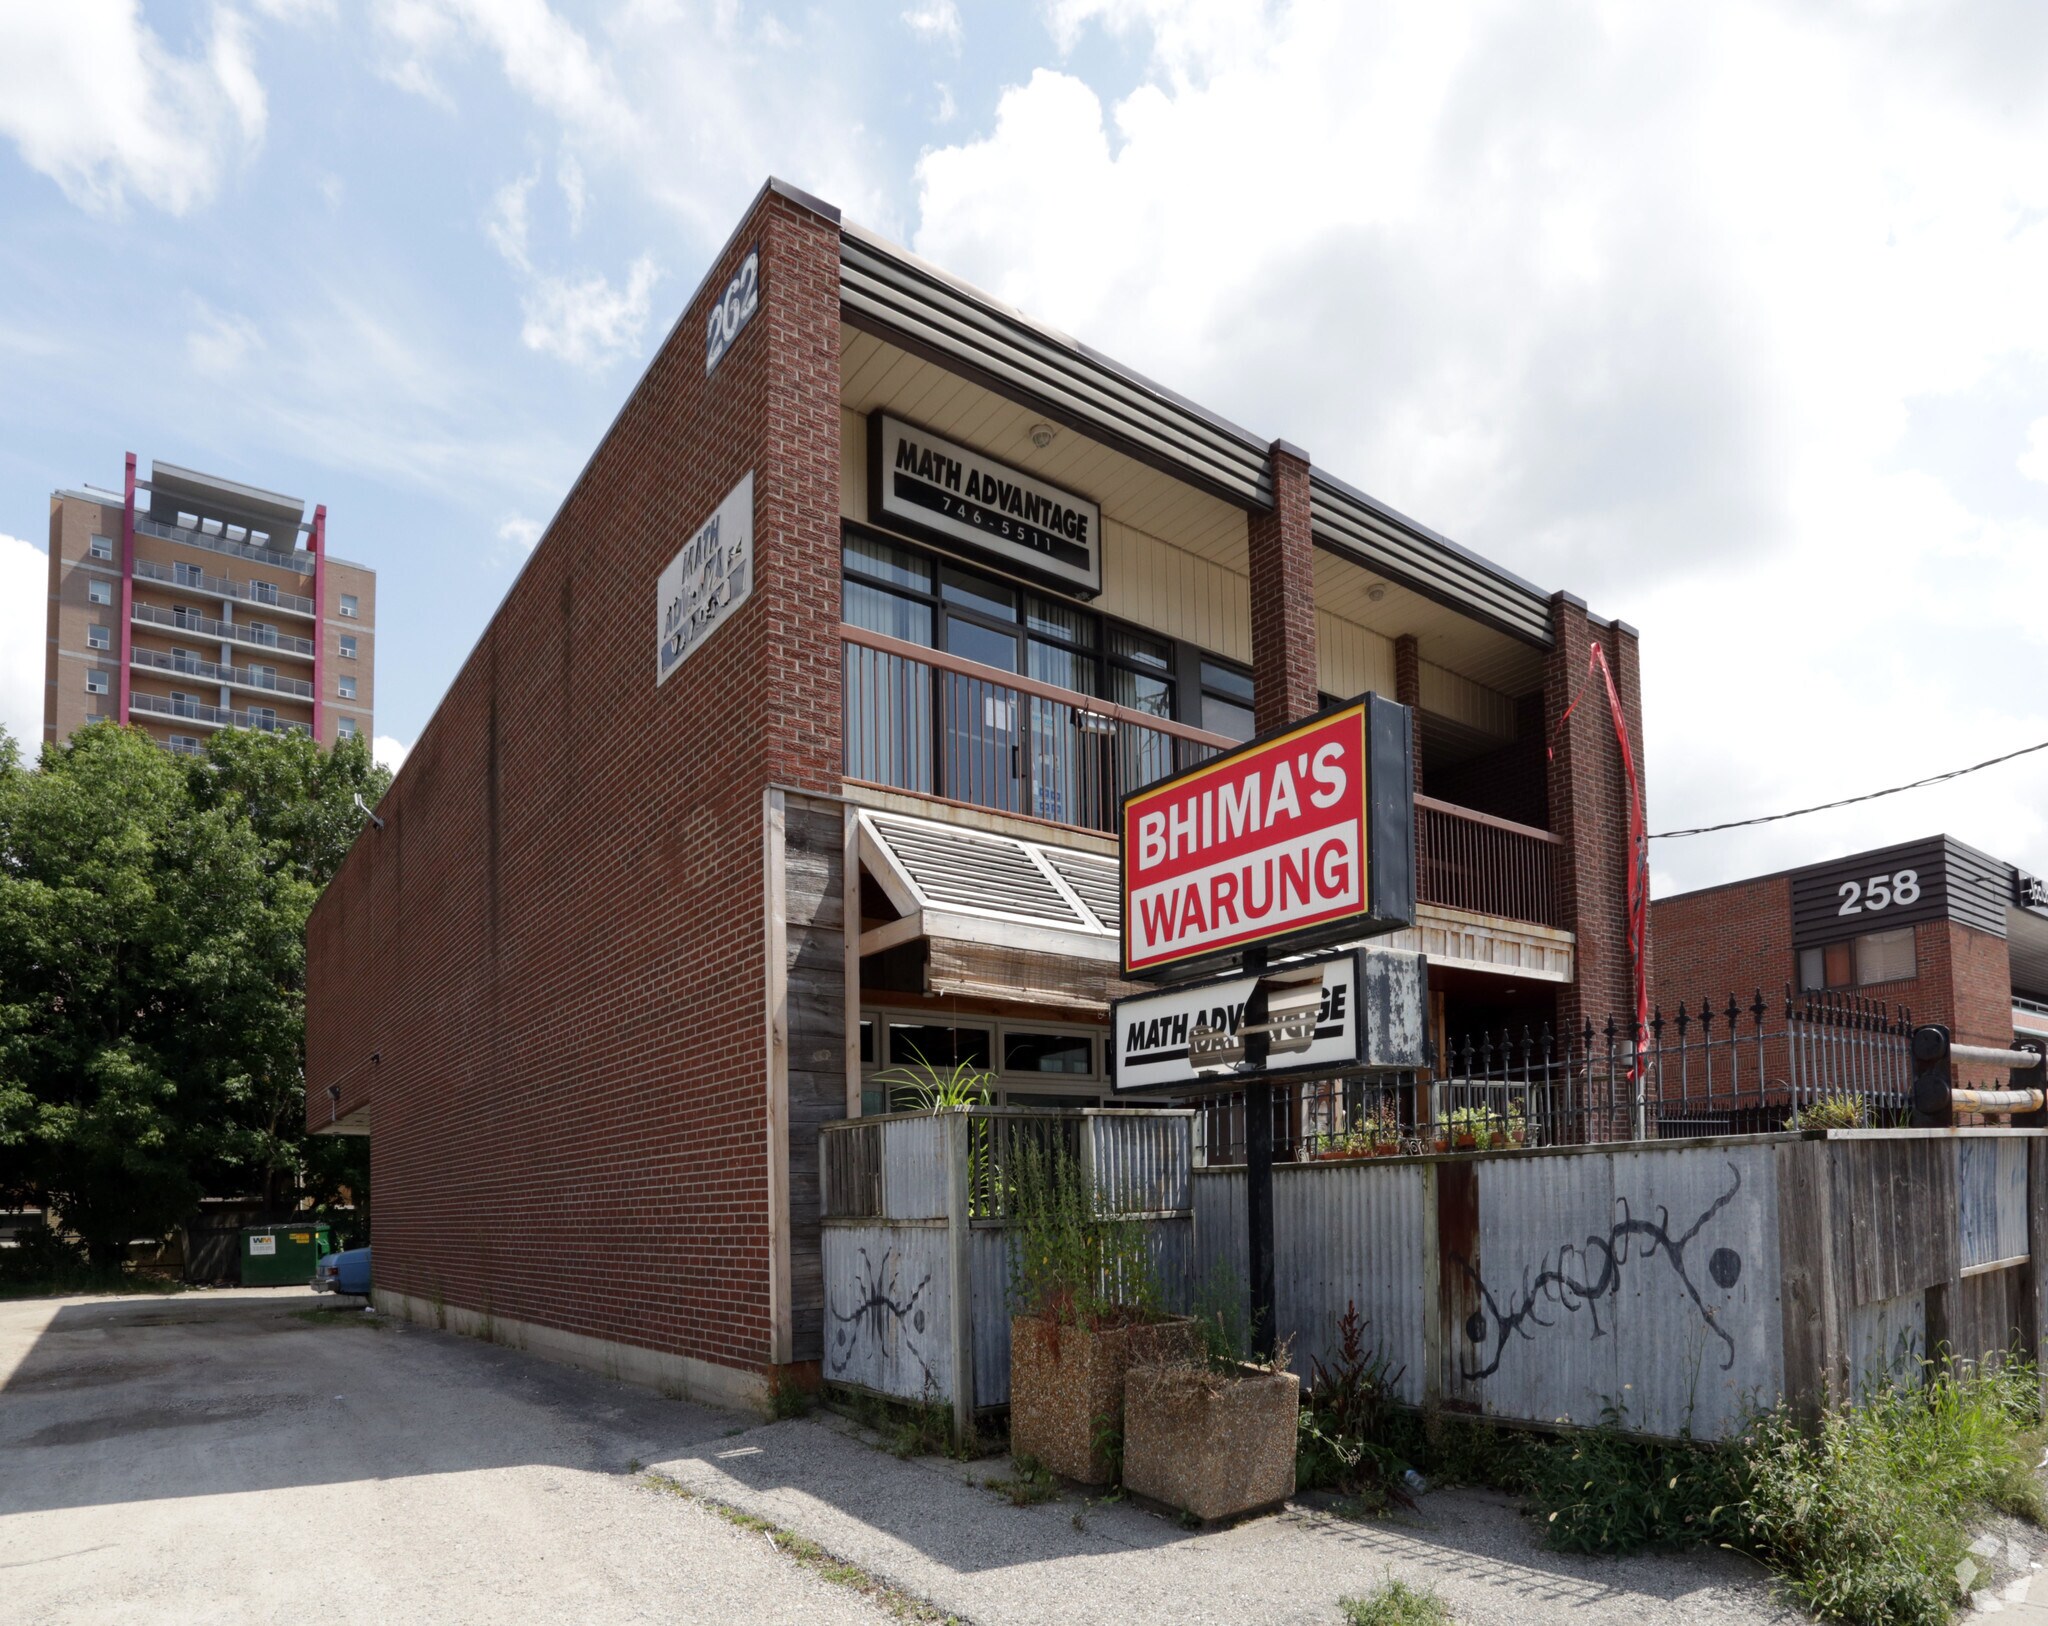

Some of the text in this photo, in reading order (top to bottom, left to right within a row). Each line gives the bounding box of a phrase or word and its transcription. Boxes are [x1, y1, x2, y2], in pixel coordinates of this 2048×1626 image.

[706, 252, 758, 370] 262
[896, 438, 1088, 545] MATH ADVANTAGE
[943, 496, 1050, 551] 746-5511
[1139, 741, 1347, 871] BHIMA'S
[1140, 838, 1349, 947] WARUNG
[1838, 869, 1920, 916] 258
[1126, 1013, 1189, 1053] MATH
[1194, 984, 1347, 1039] ADVGE
